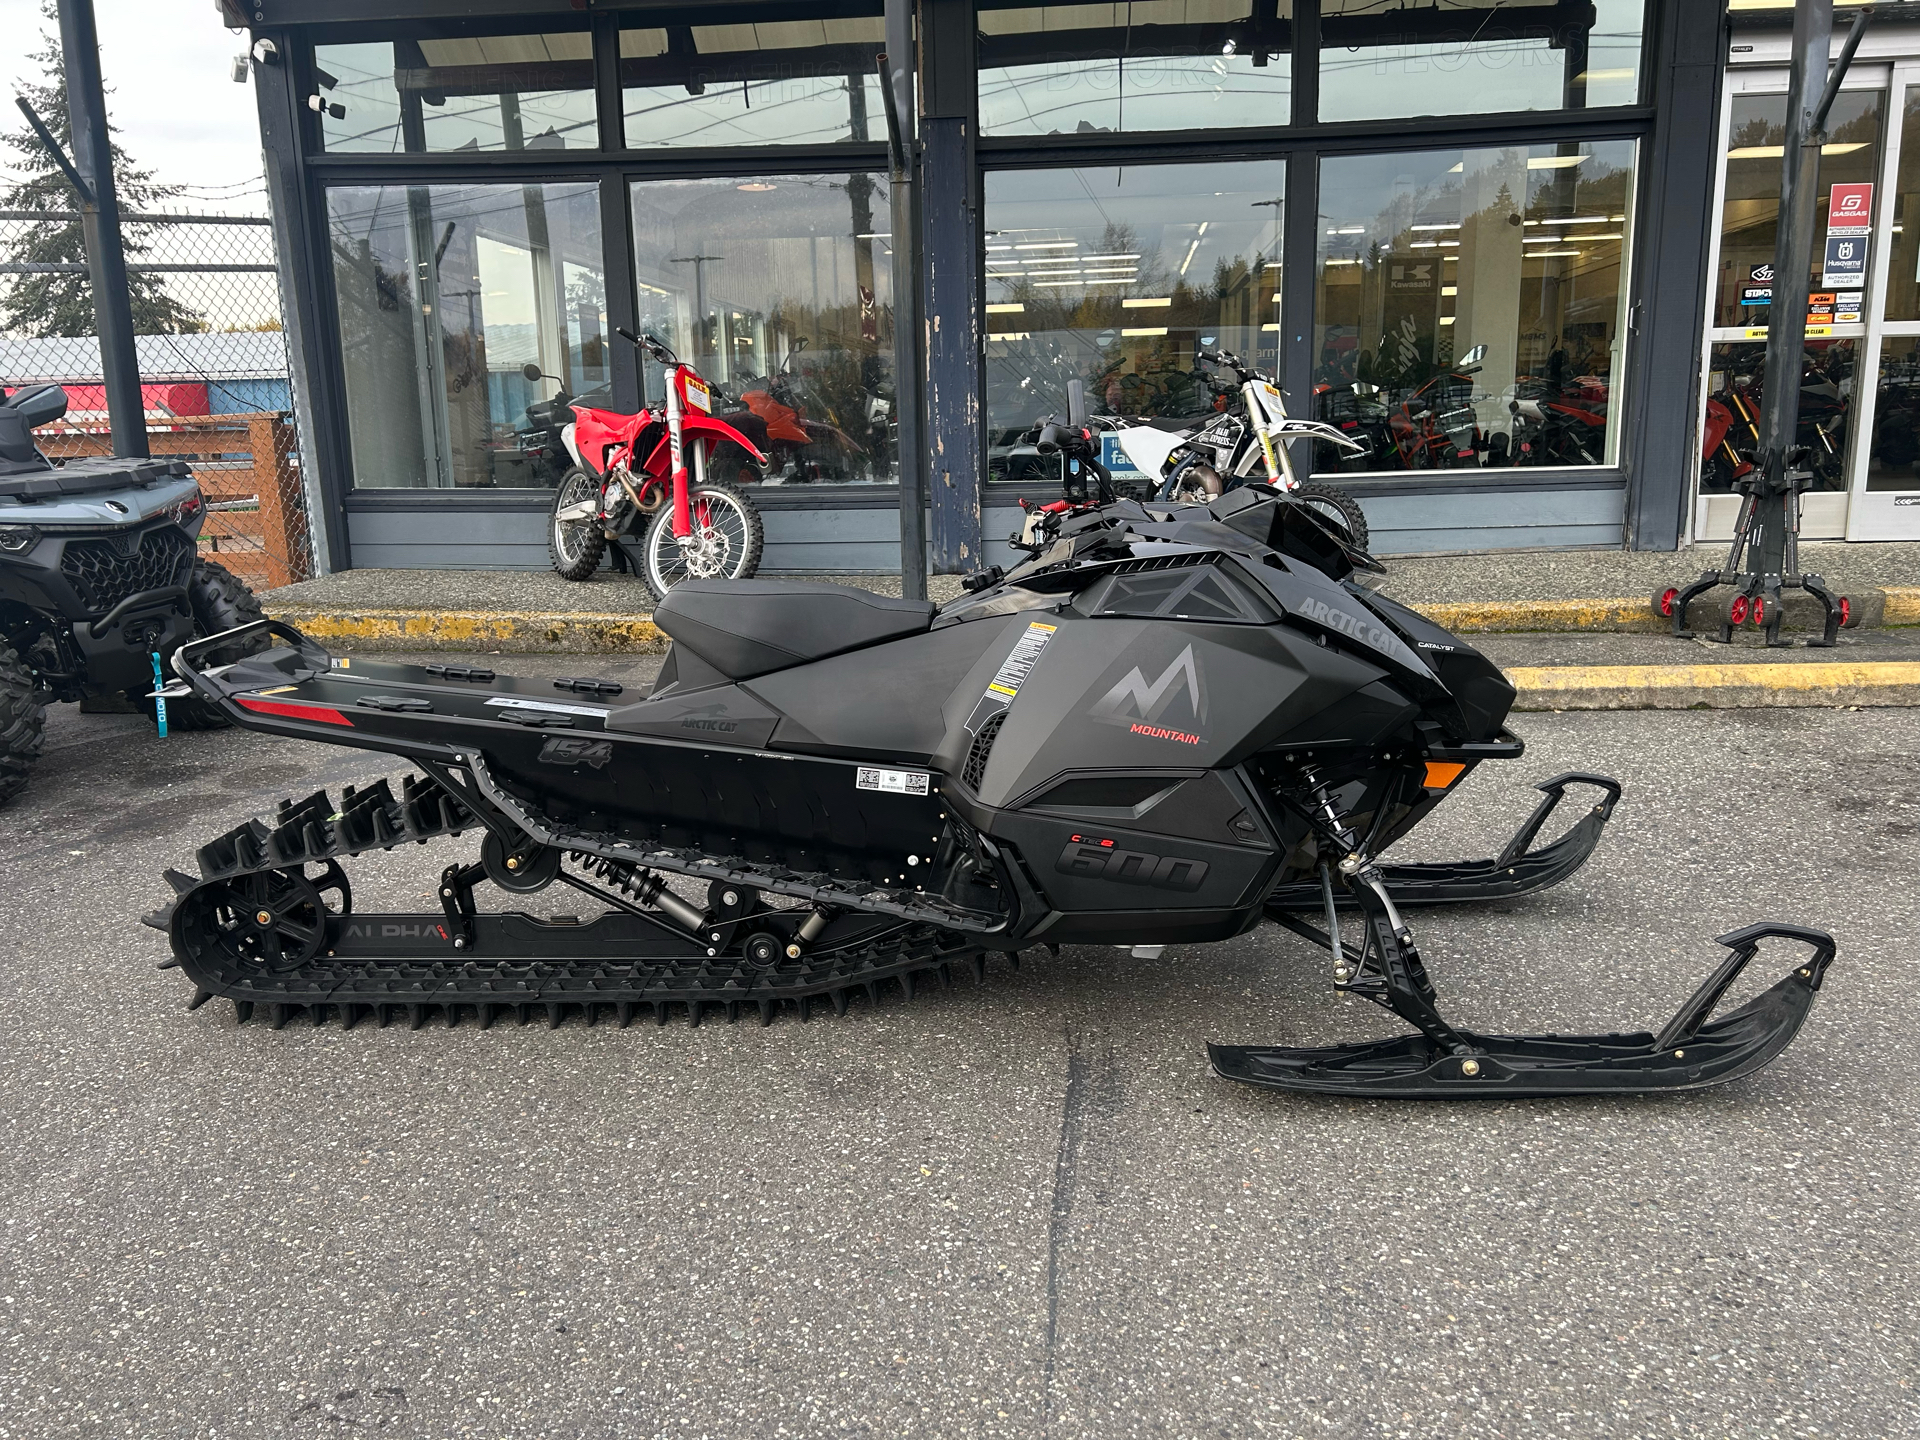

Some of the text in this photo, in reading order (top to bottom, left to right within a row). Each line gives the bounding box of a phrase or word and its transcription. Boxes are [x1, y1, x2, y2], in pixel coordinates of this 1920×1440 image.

[1375, 22, 1585, 75] FLOORS
[690, 61, 845, 105] BATHS
[1047, 43, 1230, 92] DOORS
[689, 379, 706, 394] SALE
[1299, 597, 1400, 656] ARCTIC CAT
[1418, 641, 1455, 651] CATALYST
[681, 718, 738, 733] ARCTIC CAT
[1130, 723, 1200, 745] MOUNTAIN
[539, 738, 612, 767] 154
[1054, 842, 1210, 893] 600
